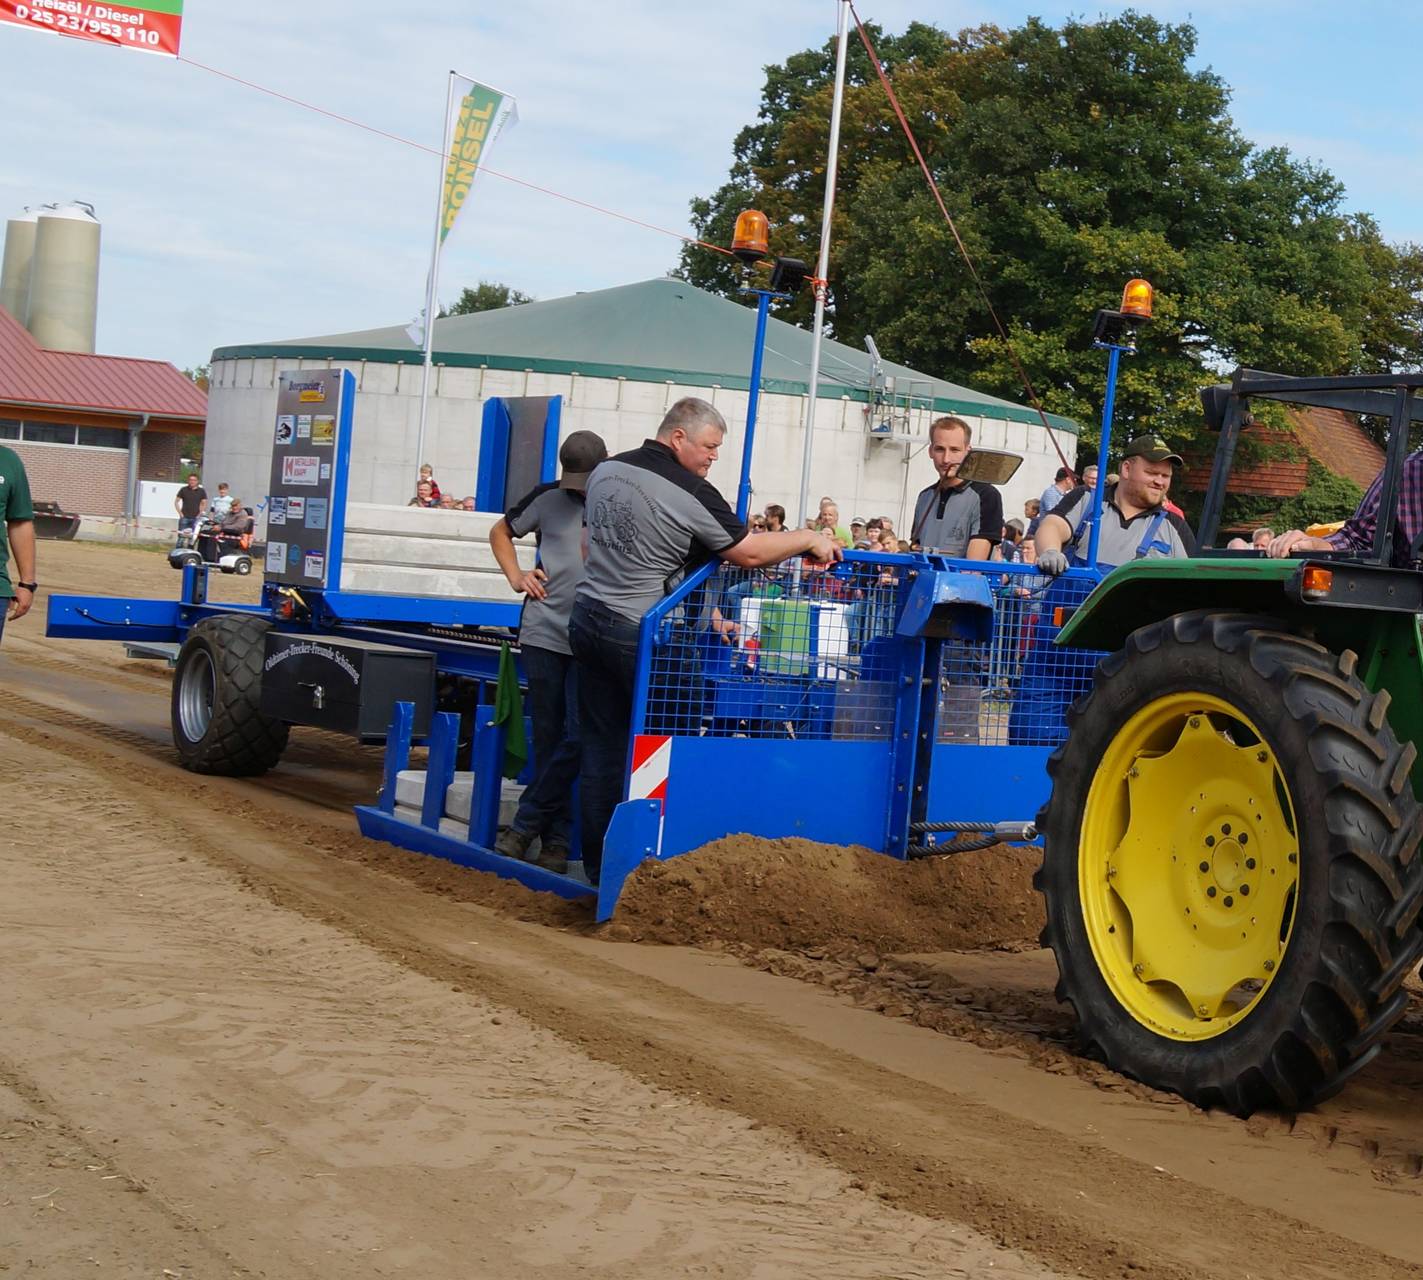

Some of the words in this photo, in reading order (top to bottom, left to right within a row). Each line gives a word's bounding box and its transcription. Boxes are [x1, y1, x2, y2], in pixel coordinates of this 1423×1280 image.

[16, 5, 28, 19] 0
[31, 8, 54, 24] 25
[57, 12, 122, 38] 23/953
[127, 27, 160, 45] 110
[95, 7, 144, 25] Diesel
